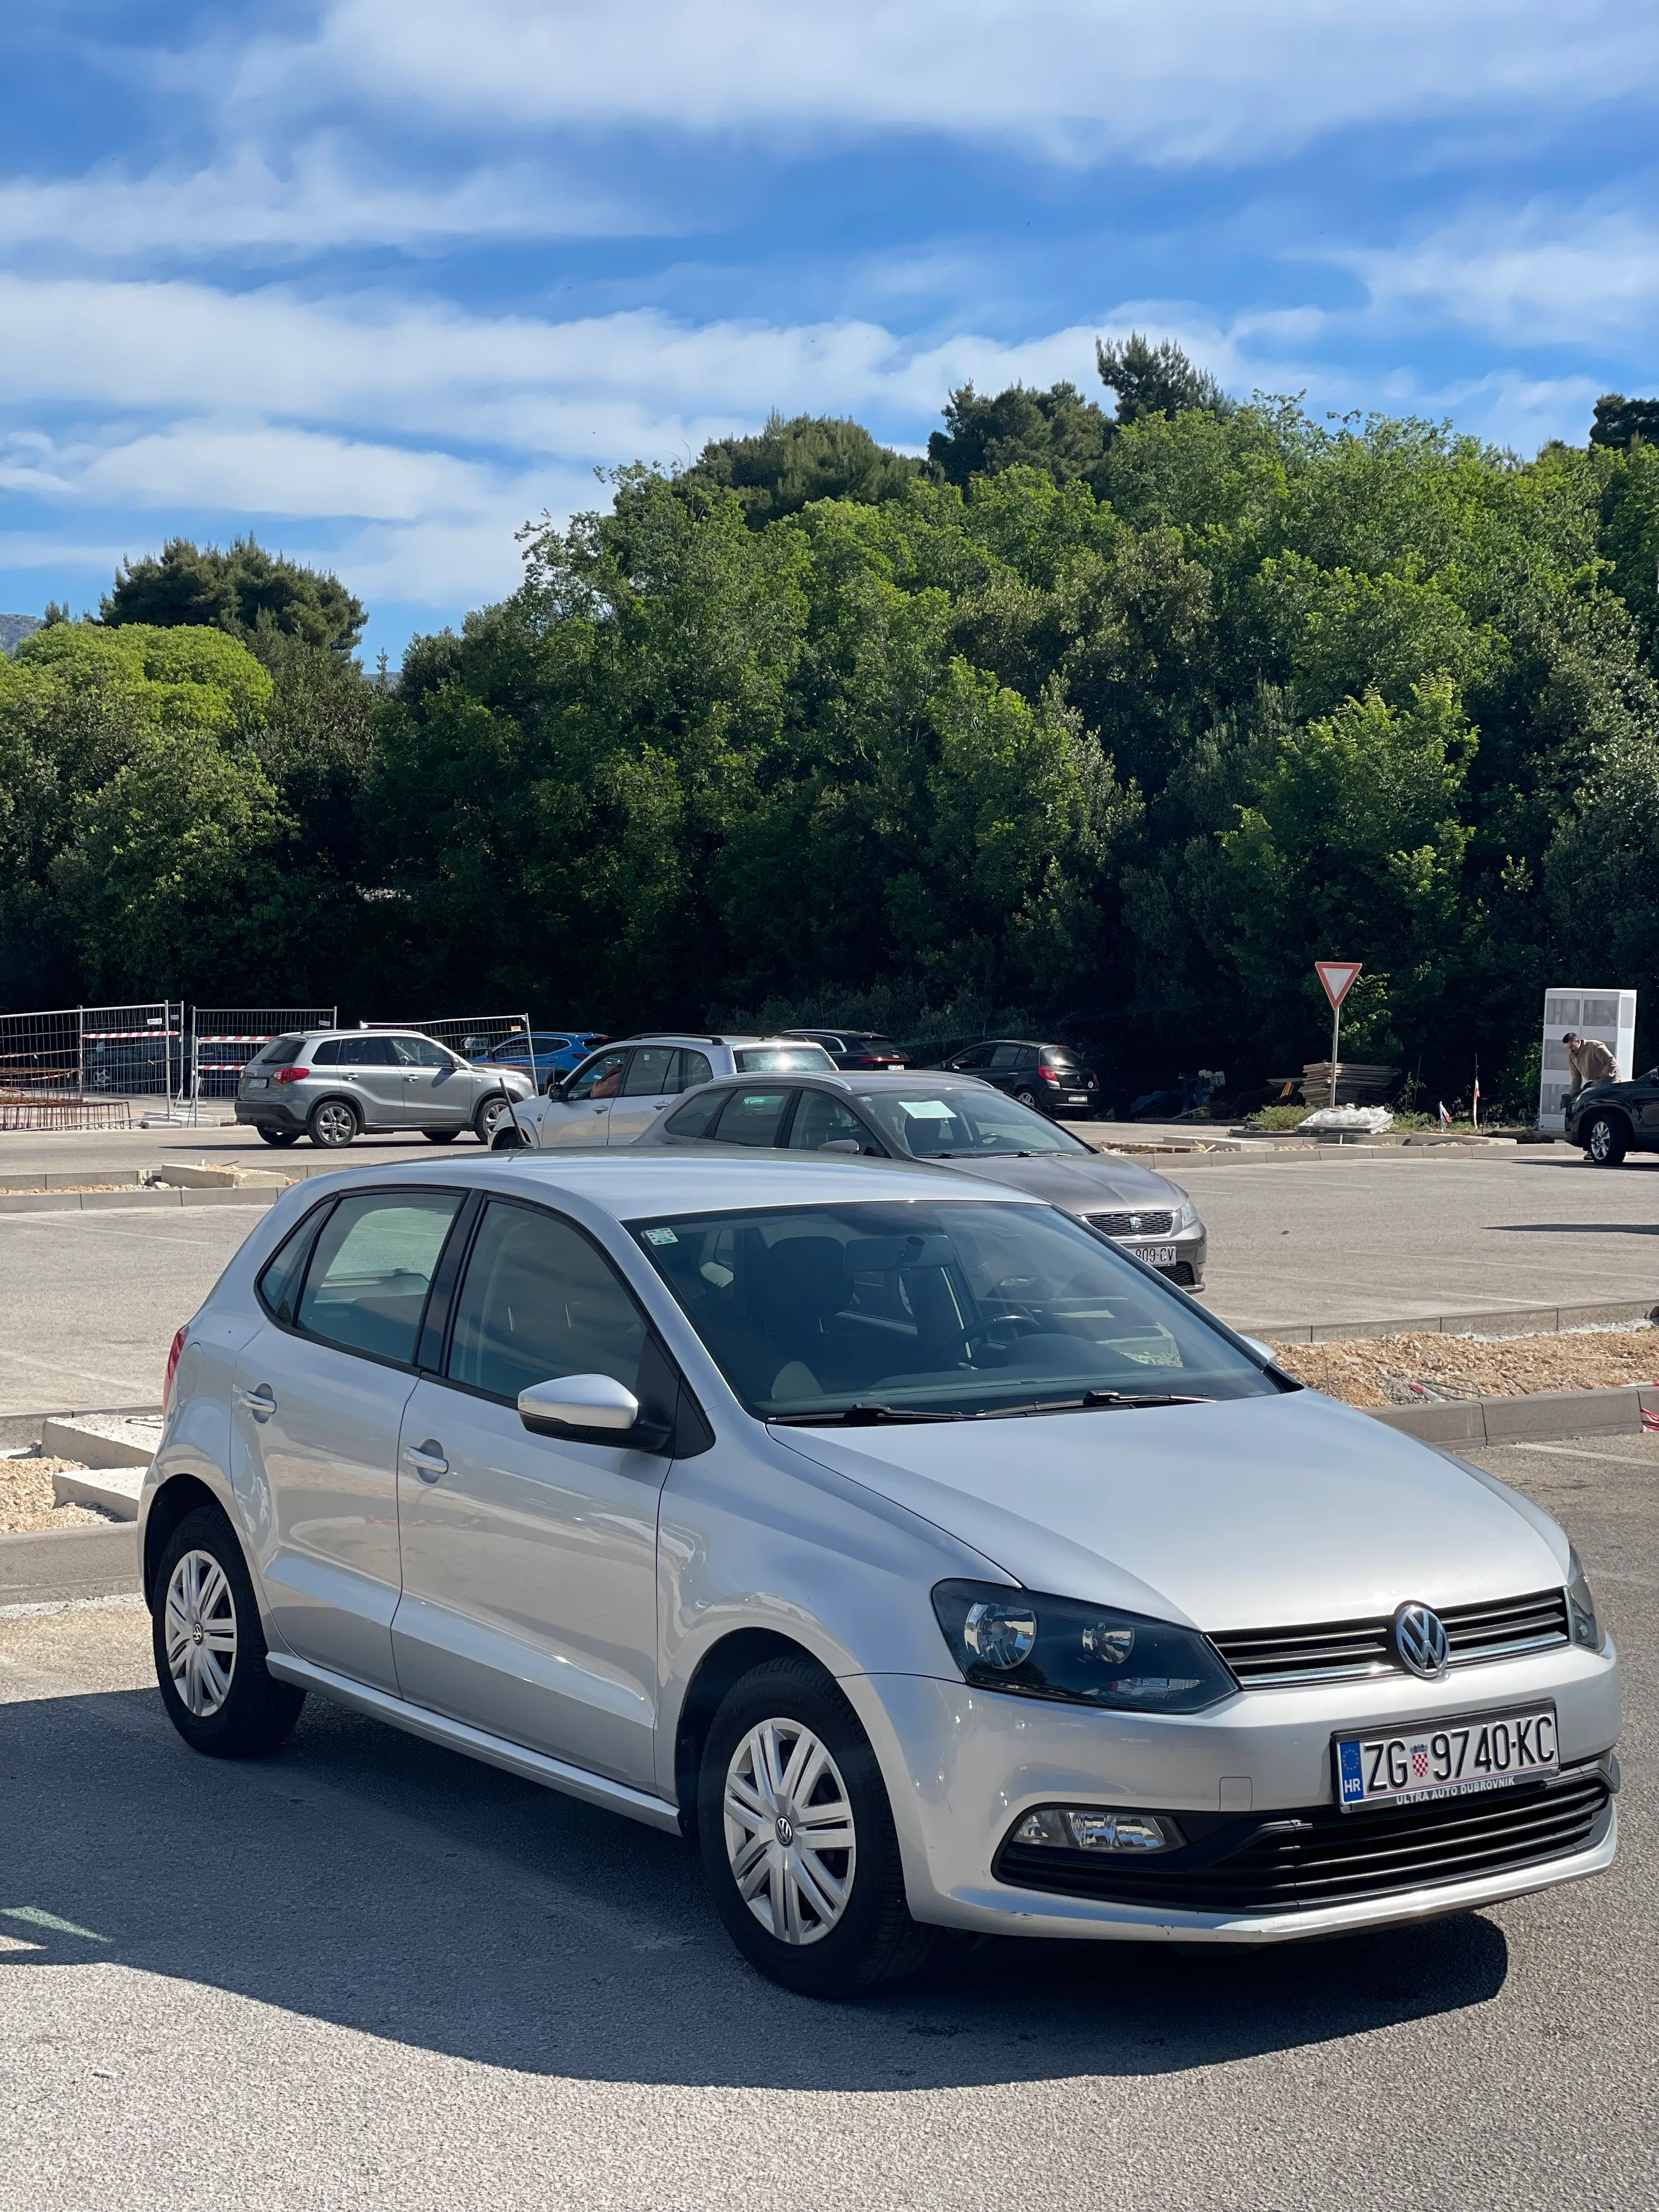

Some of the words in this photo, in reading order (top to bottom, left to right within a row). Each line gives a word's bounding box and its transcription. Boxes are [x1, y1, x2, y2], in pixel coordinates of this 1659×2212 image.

[1364, 1739, 1408, 1793] ZG
[1345, 1778, 1361, 1793] HR
[1396, 1792, 1430, 1805] ULTRA
[1431, 1787, 1457, 1800] AUTO
[1460, 1776, 1515, 1794] DUBROVNIK
